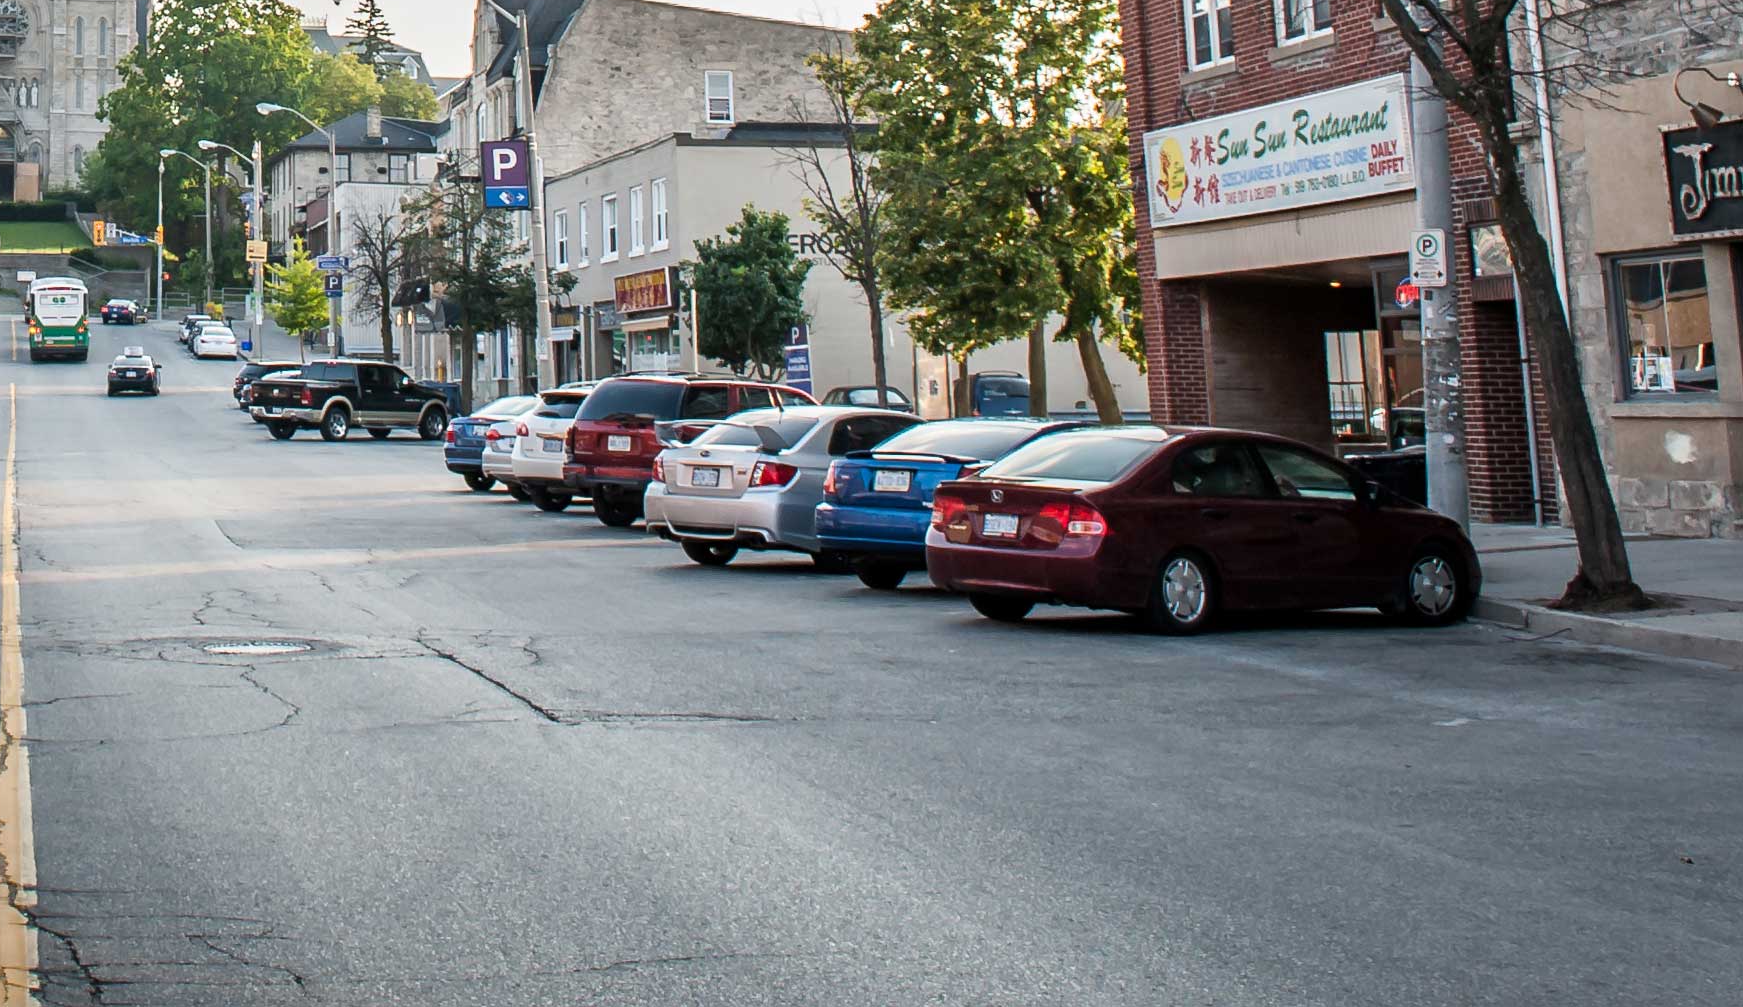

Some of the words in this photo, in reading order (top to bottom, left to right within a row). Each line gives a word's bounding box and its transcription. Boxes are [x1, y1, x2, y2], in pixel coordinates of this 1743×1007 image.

[1216, 127, 1248, 165] Sun
[1253, 120, 1286, 158] Sun
[1292, 100, 1388, 146] Restaurant
[1370, 139, 1398, 160] DAILY
[492, 148, 518, 181] P
[1282, 153, 1332, 177] CANTONESE
[1334, 146, 1369, 167] CUISINE
[1368, 156, 1404, 178] BUFFET
[1672, 142, 1743, 221] Jim
[1422, 239, 1433, 253] P
[329, 276, 339, 289] P
[791, 327, 800, 344] P
